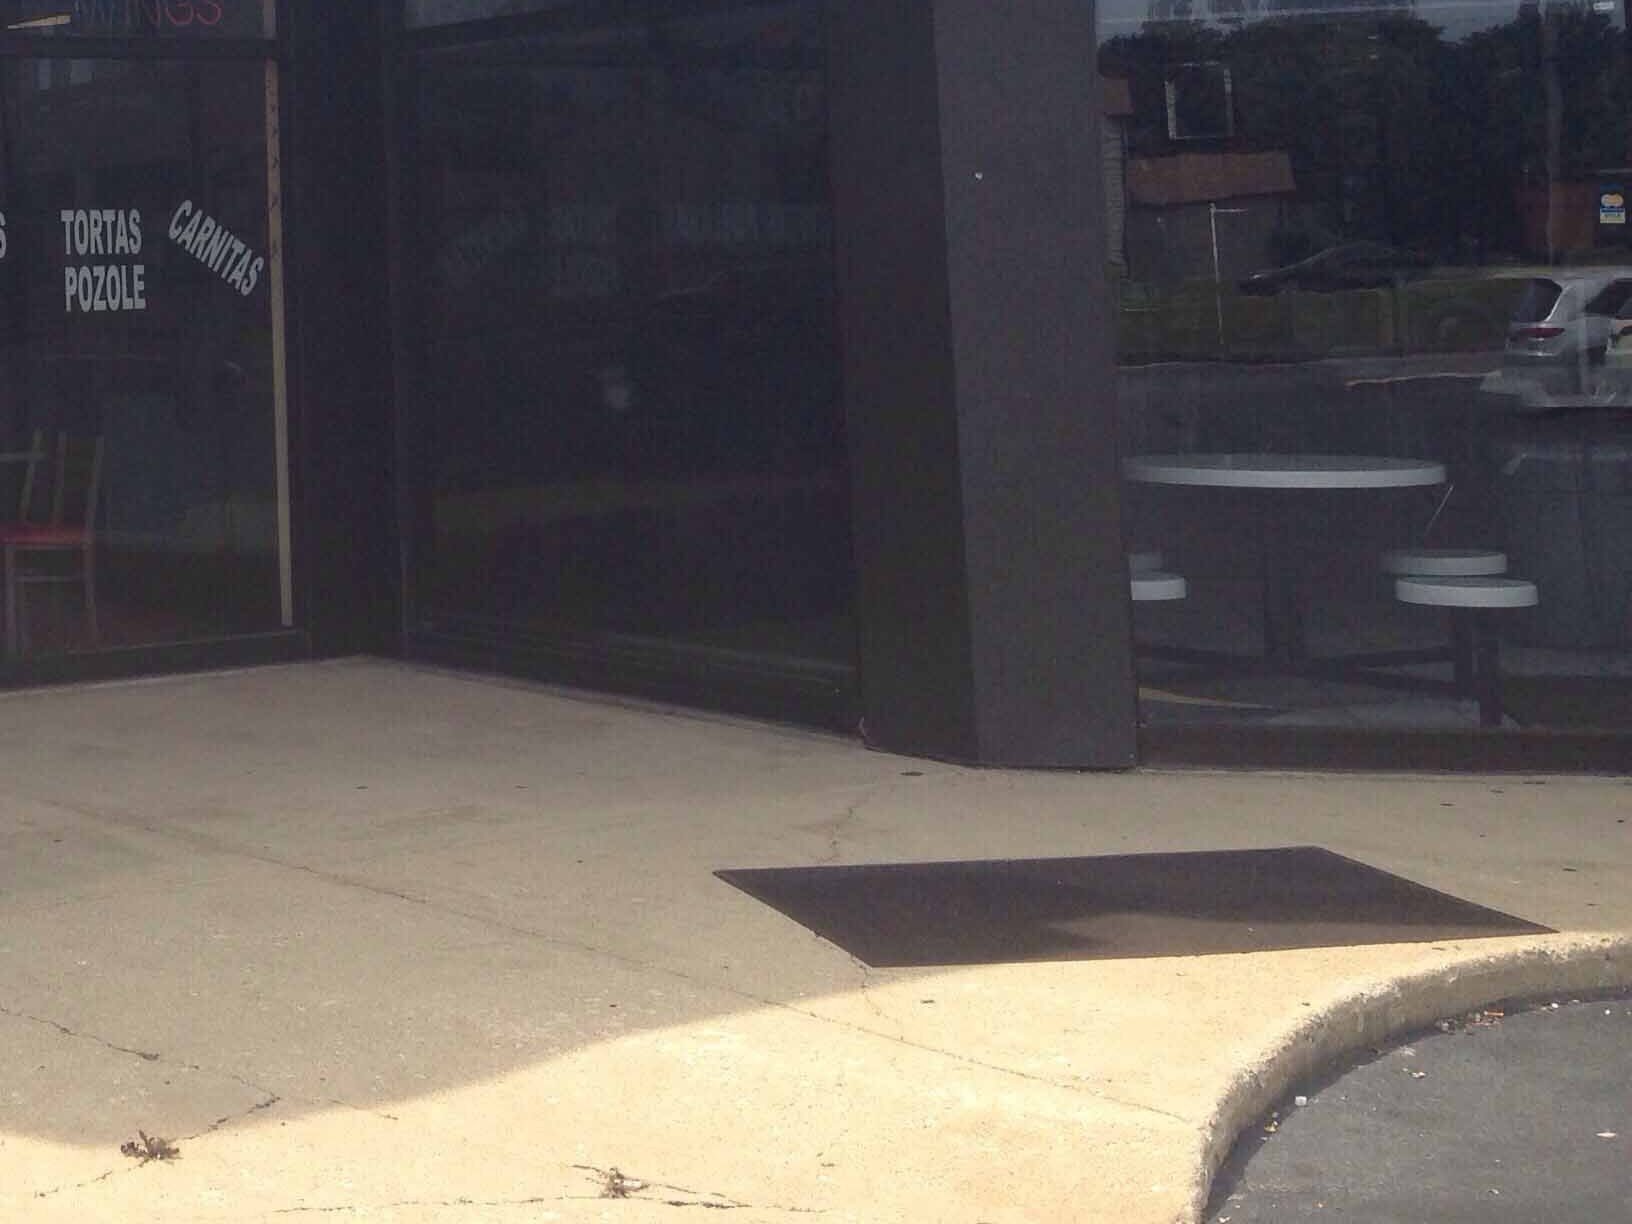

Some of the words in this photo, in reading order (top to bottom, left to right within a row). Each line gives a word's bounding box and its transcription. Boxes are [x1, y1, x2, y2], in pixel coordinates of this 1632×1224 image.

[61, 208, 142, 256] TORTAS
[168, 199, 265, 296] CARNITAS
[64, 264, 146, 313] POZOLE
